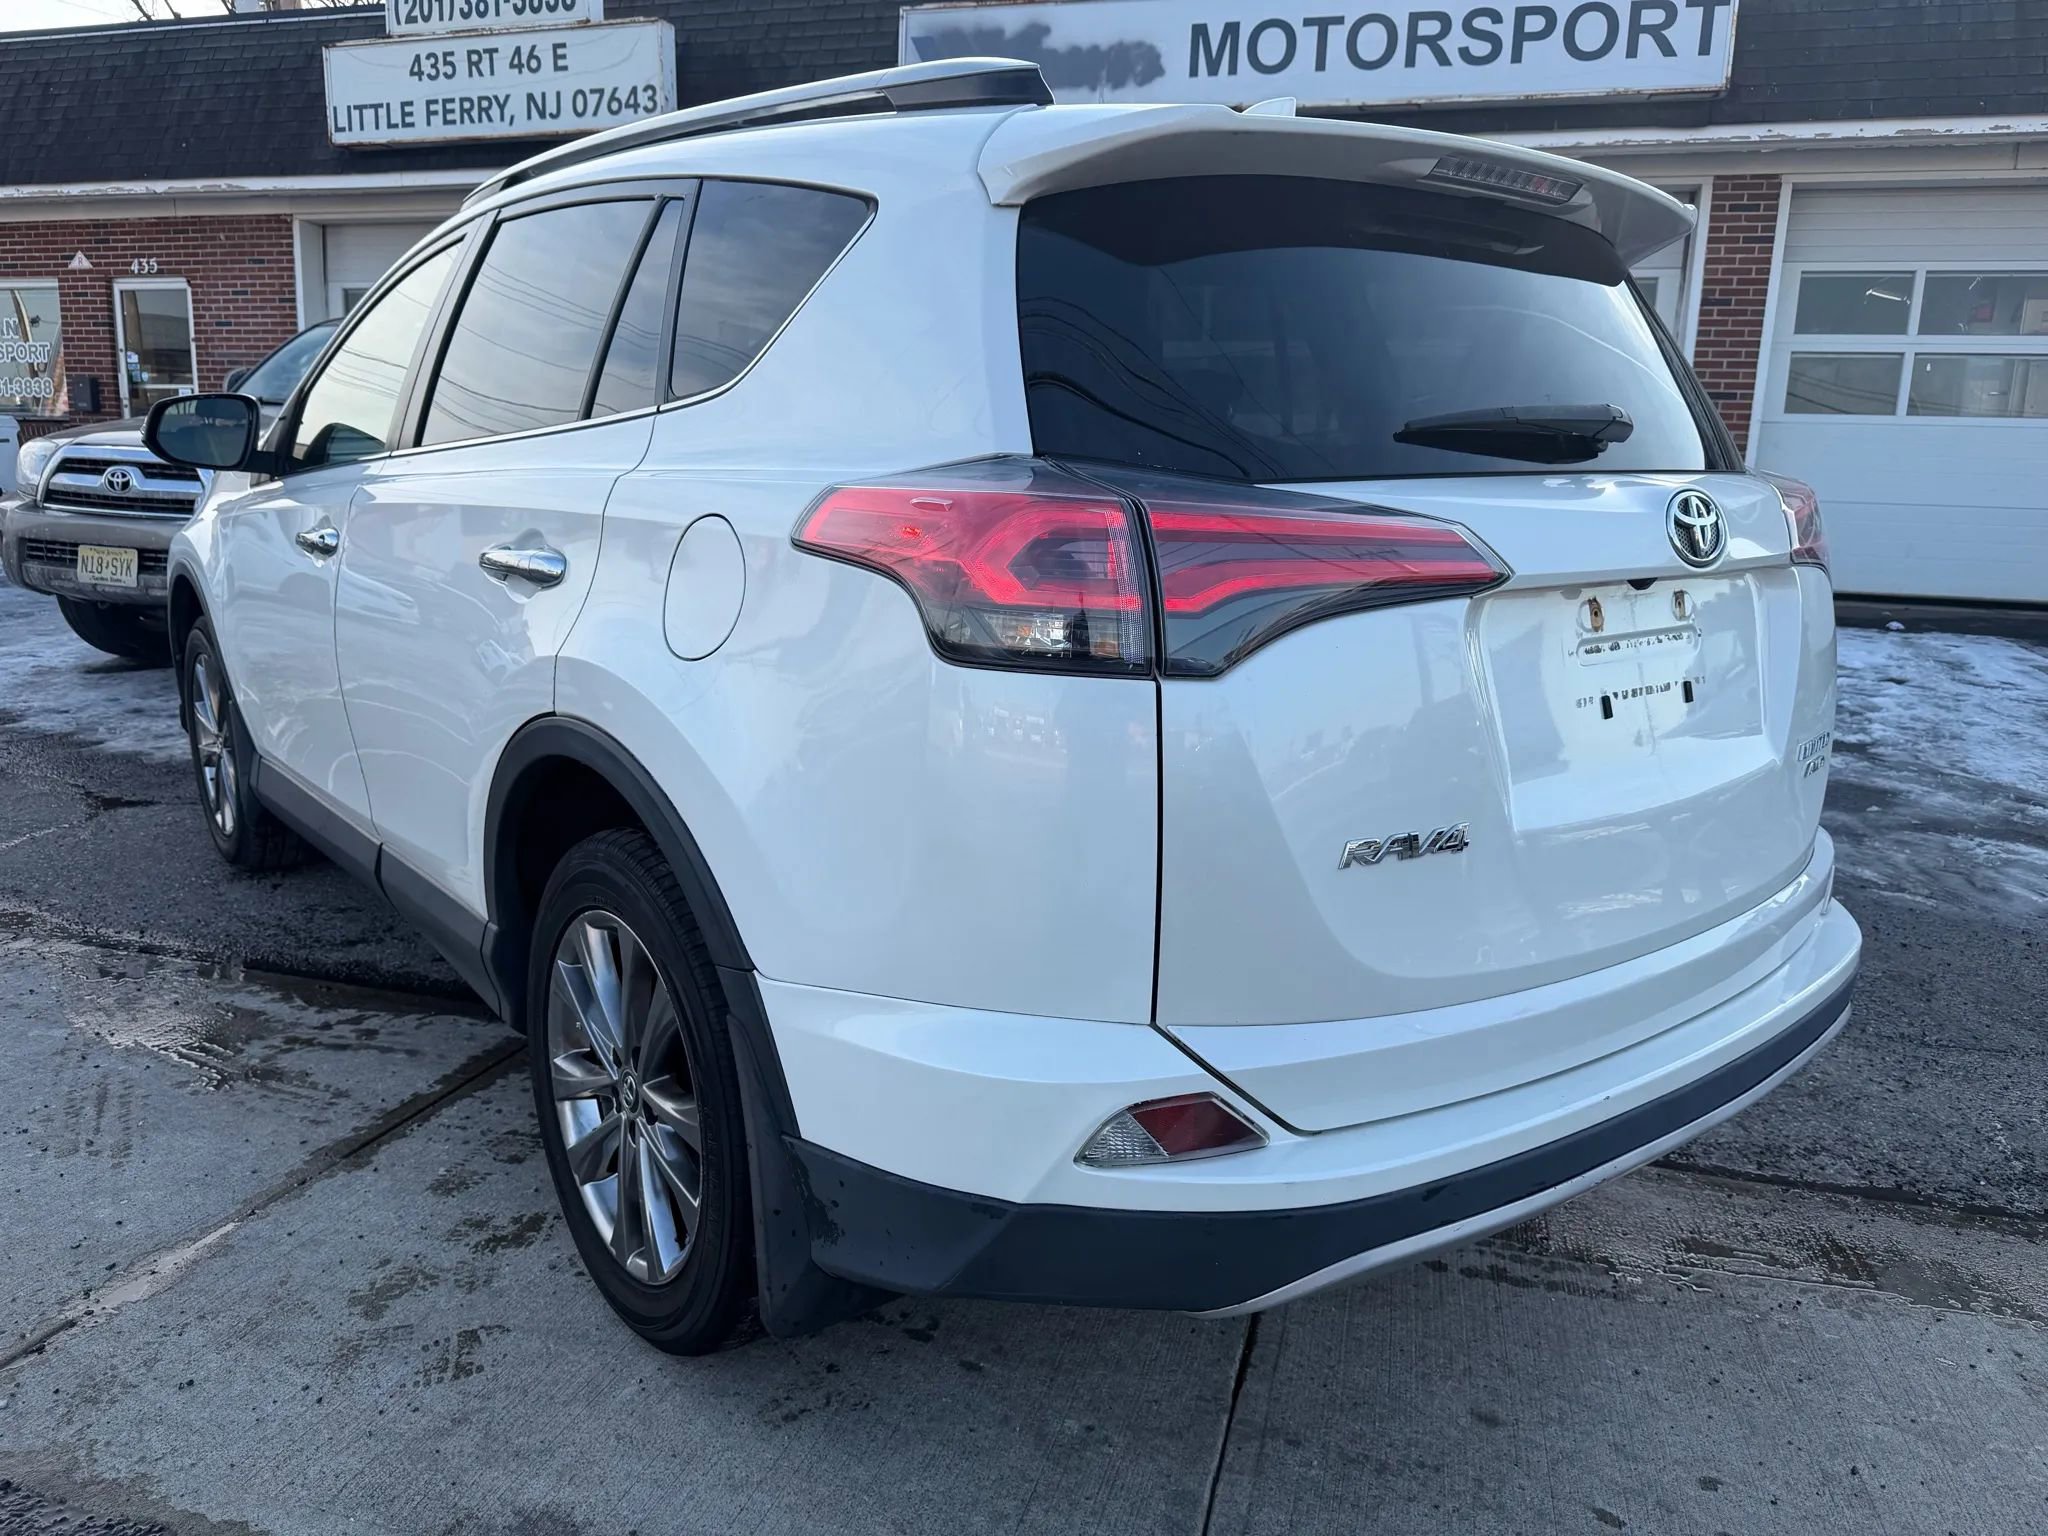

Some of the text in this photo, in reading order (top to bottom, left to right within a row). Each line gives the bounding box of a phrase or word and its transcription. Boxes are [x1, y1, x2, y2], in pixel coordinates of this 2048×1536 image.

[1189, 0, 1731, 78] MOTORSPORT
[409, 42, 569, 82] 435 RT 46 E
[333, 84, 658, 133] LITTLE FERRY, NJ 07643
[130, 257, 158, 274] 435
[0, 377, 54, 397] 1-3838
[1338, 822, 1471, 869] RAV4
